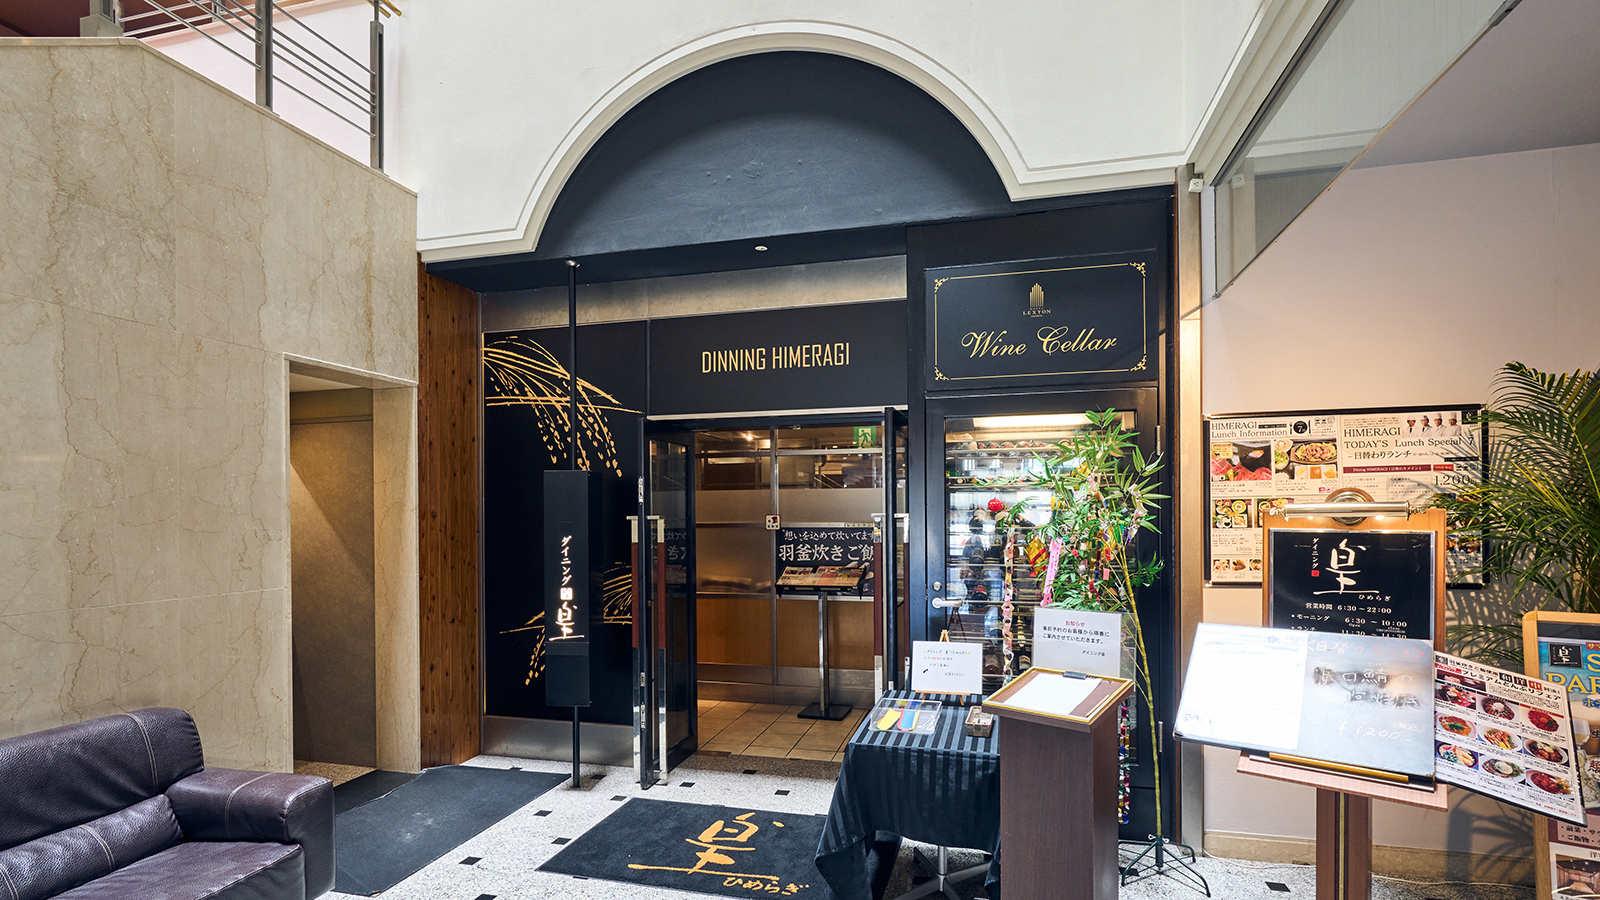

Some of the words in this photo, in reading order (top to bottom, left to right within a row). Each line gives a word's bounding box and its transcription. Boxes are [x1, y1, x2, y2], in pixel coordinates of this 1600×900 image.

[961, 330, 1027, 358] Wine
[1036, 326, 1117, 356] Cellar
[701, 346, 766, 374] DINNING
[772, 342, 851, 369] HIMERAGI
[1211, 422, 1257, 430] HIMERAGI
[1211, 430, 1236, 438] Lunch
[1240, 426, 1288, 437] Information
[1343, 427, 1401, 438] HIMERAGI
[1395, 438, 1425, 448] Lunch
[1428, 436, 1462, 447] Special
[1354, 450, 1412, 460] 日替わりランチ
[1312, 537, 1320, 569] ダイニング
[560, 535, 572, 586] ダイニング
[1358, 594, 1391, 602] ひめらぎ
[1305, 602, 1333, 611] 営業時間
[1297, 614, 1330, 622] モーニング
[1042, 633, 1103, 644] ご案内させていただきます。
[723, 876, 810, 896] ひめらぎ
